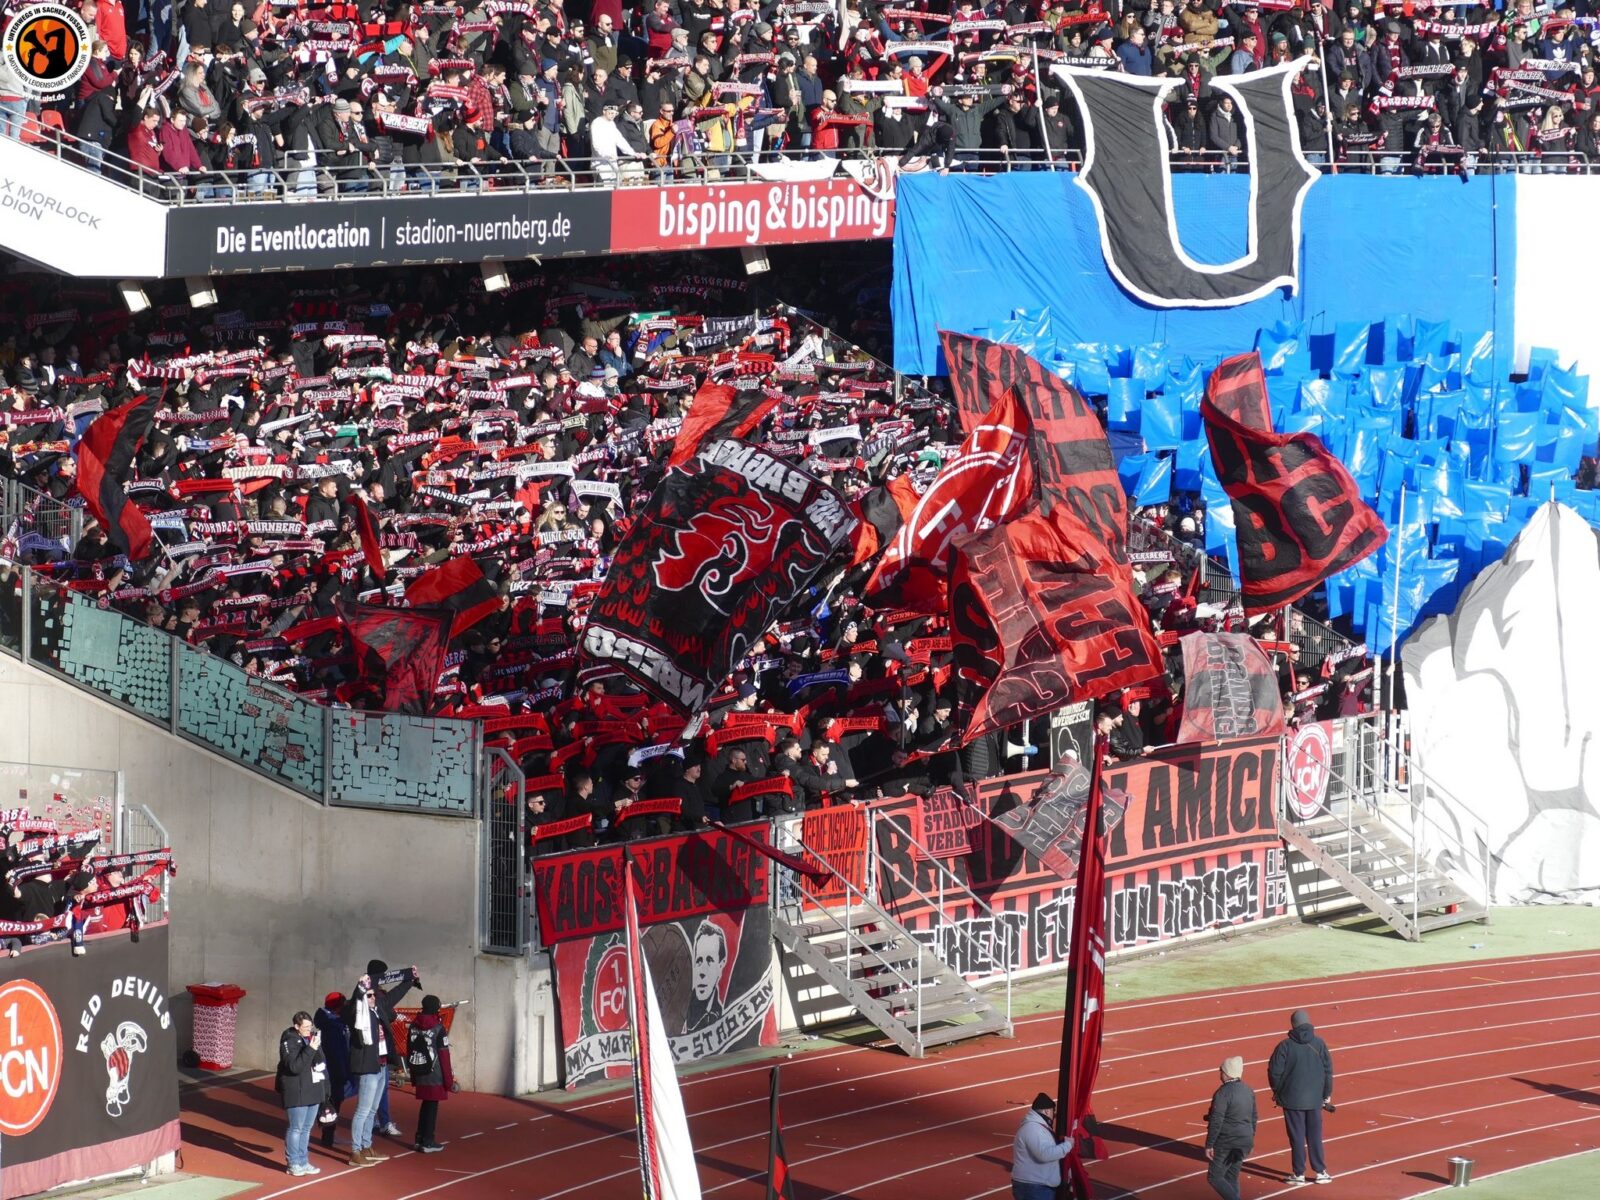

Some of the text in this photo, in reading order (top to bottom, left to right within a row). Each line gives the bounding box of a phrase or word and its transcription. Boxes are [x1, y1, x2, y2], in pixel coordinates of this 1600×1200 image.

[1057, 56, 1116, 66] NÜRNBERG
[1, 178, 102, 230] X MORLOCK
[1, 194, 44, 221] DION
[658, 180, 888, 246] bisping & bisping
[216, 222, 370, 254] Die Eventlocation
[394, 212, 571, 246] stadion-nuernberg.de
[418, 484, 473, 505] NÜRNBERG
[248, 521, 302, 534] NÜRNBERG
[1140, 748, 1277, 851] AMICI
[652, 828, 765, 914] BAGAGE
[610, 959, 624, 984] 1.
[4, 1001, 24, 1048] 1.
[75, 975, 171, 1054] RED DEVILS
[0, 1050, 49, 1100] CN
